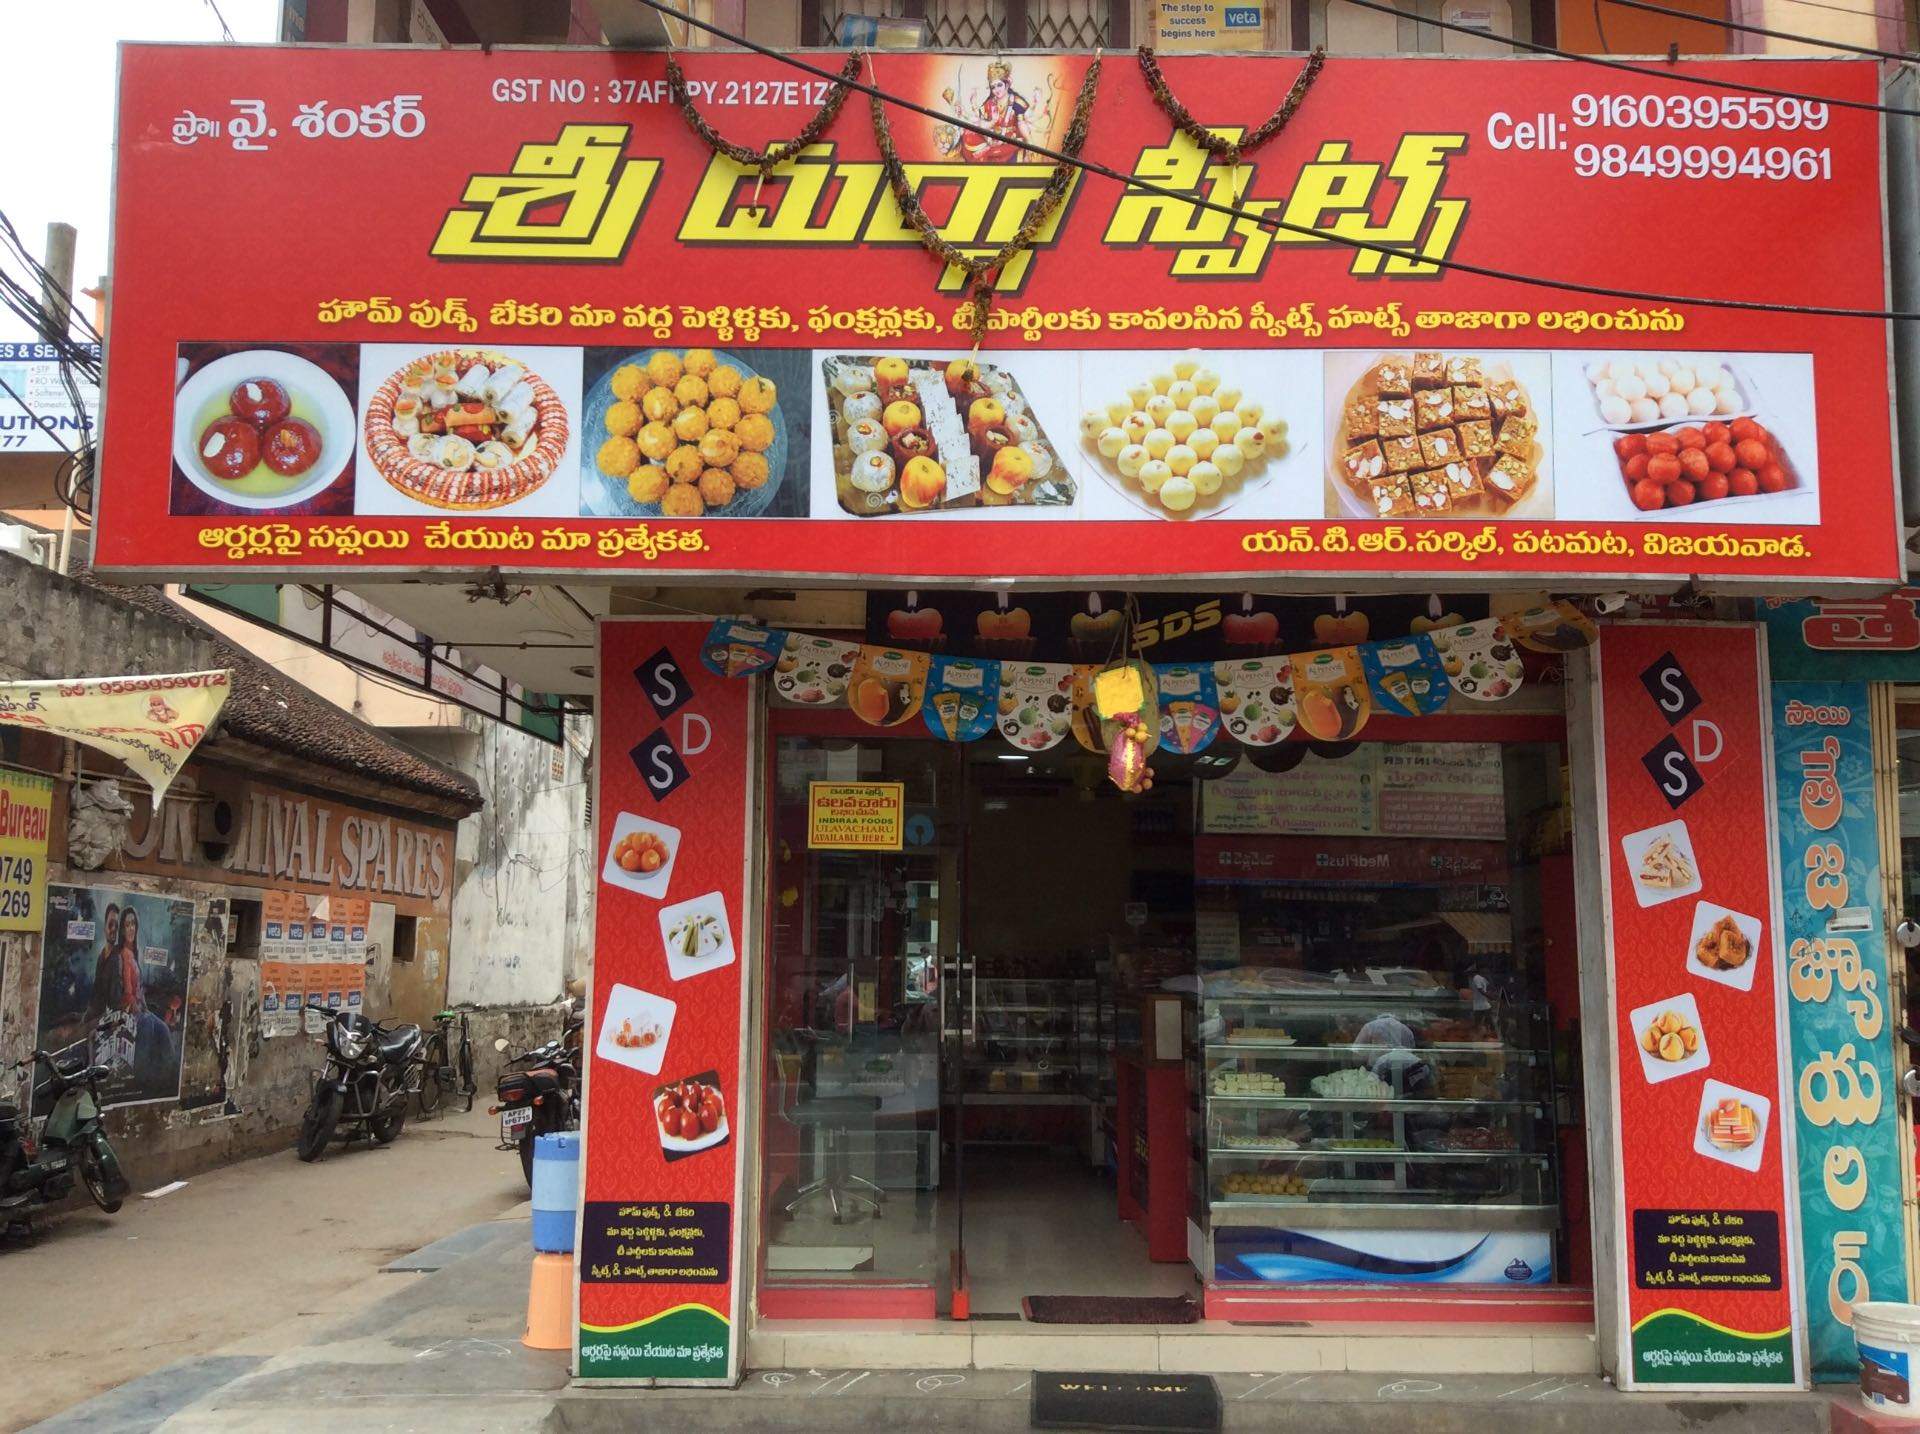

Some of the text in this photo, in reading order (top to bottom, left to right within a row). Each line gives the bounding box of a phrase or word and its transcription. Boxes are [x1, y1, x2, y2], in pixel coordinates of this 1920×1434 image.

[1161, 3, 1215, 13] The step to
[1169, 17, 1207, 25] success
[1228, 10, 1257, 24] veta
[1161, 29, 1192, 39] begins
[1195, 29, 1216, 38] here
[492, 79, 541, 103] GST
[549, 79, 585, 103] NO
[291, 95, 426, 138] శంకర్
[1487, 94, 1829, 152] Cell: 9160395599
[1574, 144, 1832, 181] 9849994961
[430, 122, 664, 259] శ్రీ
[489, 300, 562, 328] బేకరి
[569, 303, 615, 328] మా
[623, 304, 672, 338] వద్ద
[1109, 304, 1243, 330] కావలసిన
[1249, 300, 1323, 338] స్వీట్స్
[1415, 308, 1530, 329] తాజాగా
[1538, 307, 1685, 332] లభించును
[198, 523, 301, 560] ఆర్డర్లపై
[309, 526, 409, 556] సప్లయి
[424, 523, 535, 552] చేయుట
[541, 529, 590, 551] మా
[1132, 600, 1222, 651] SDS
[0, 789, 48, 840] Bureau
[816, 825, 894, 833] ULAVACHARU
[121, 772, 445, 900] ORINAL SPARES
